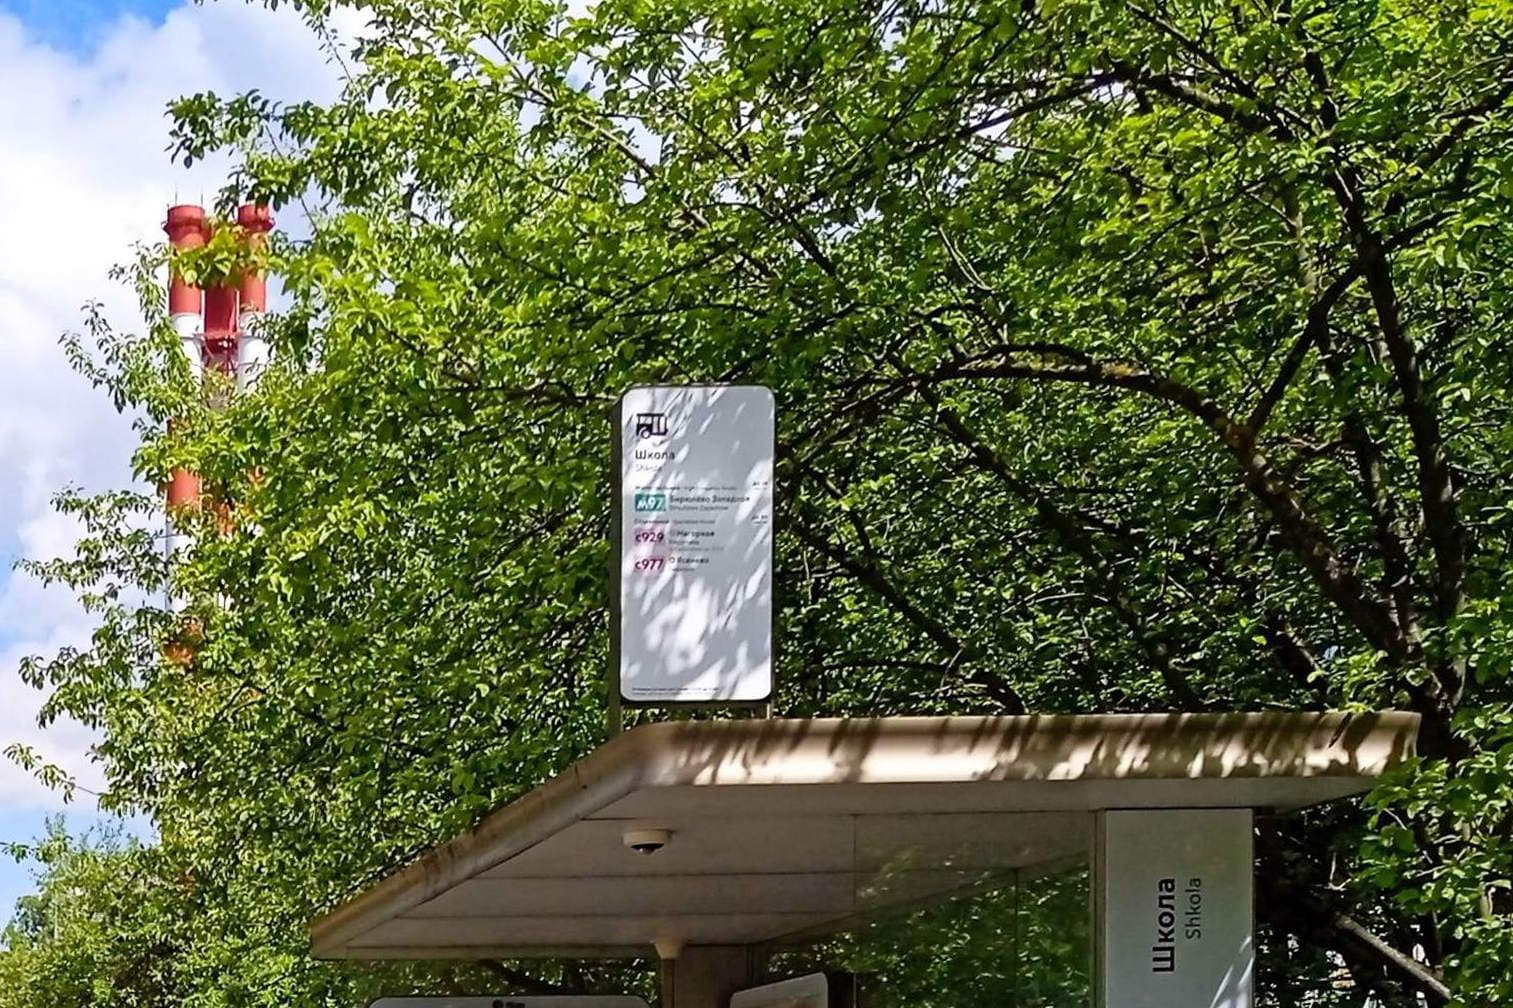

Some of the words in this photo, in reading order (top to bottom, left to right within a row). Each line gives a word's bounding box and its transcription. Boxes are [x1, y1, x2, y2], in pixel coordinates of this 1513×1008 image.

[635, 449, 675, 460] Школа
[1152, 878, 1175, 972] Школа
[1185, 878, 1201, 939] Shkola
